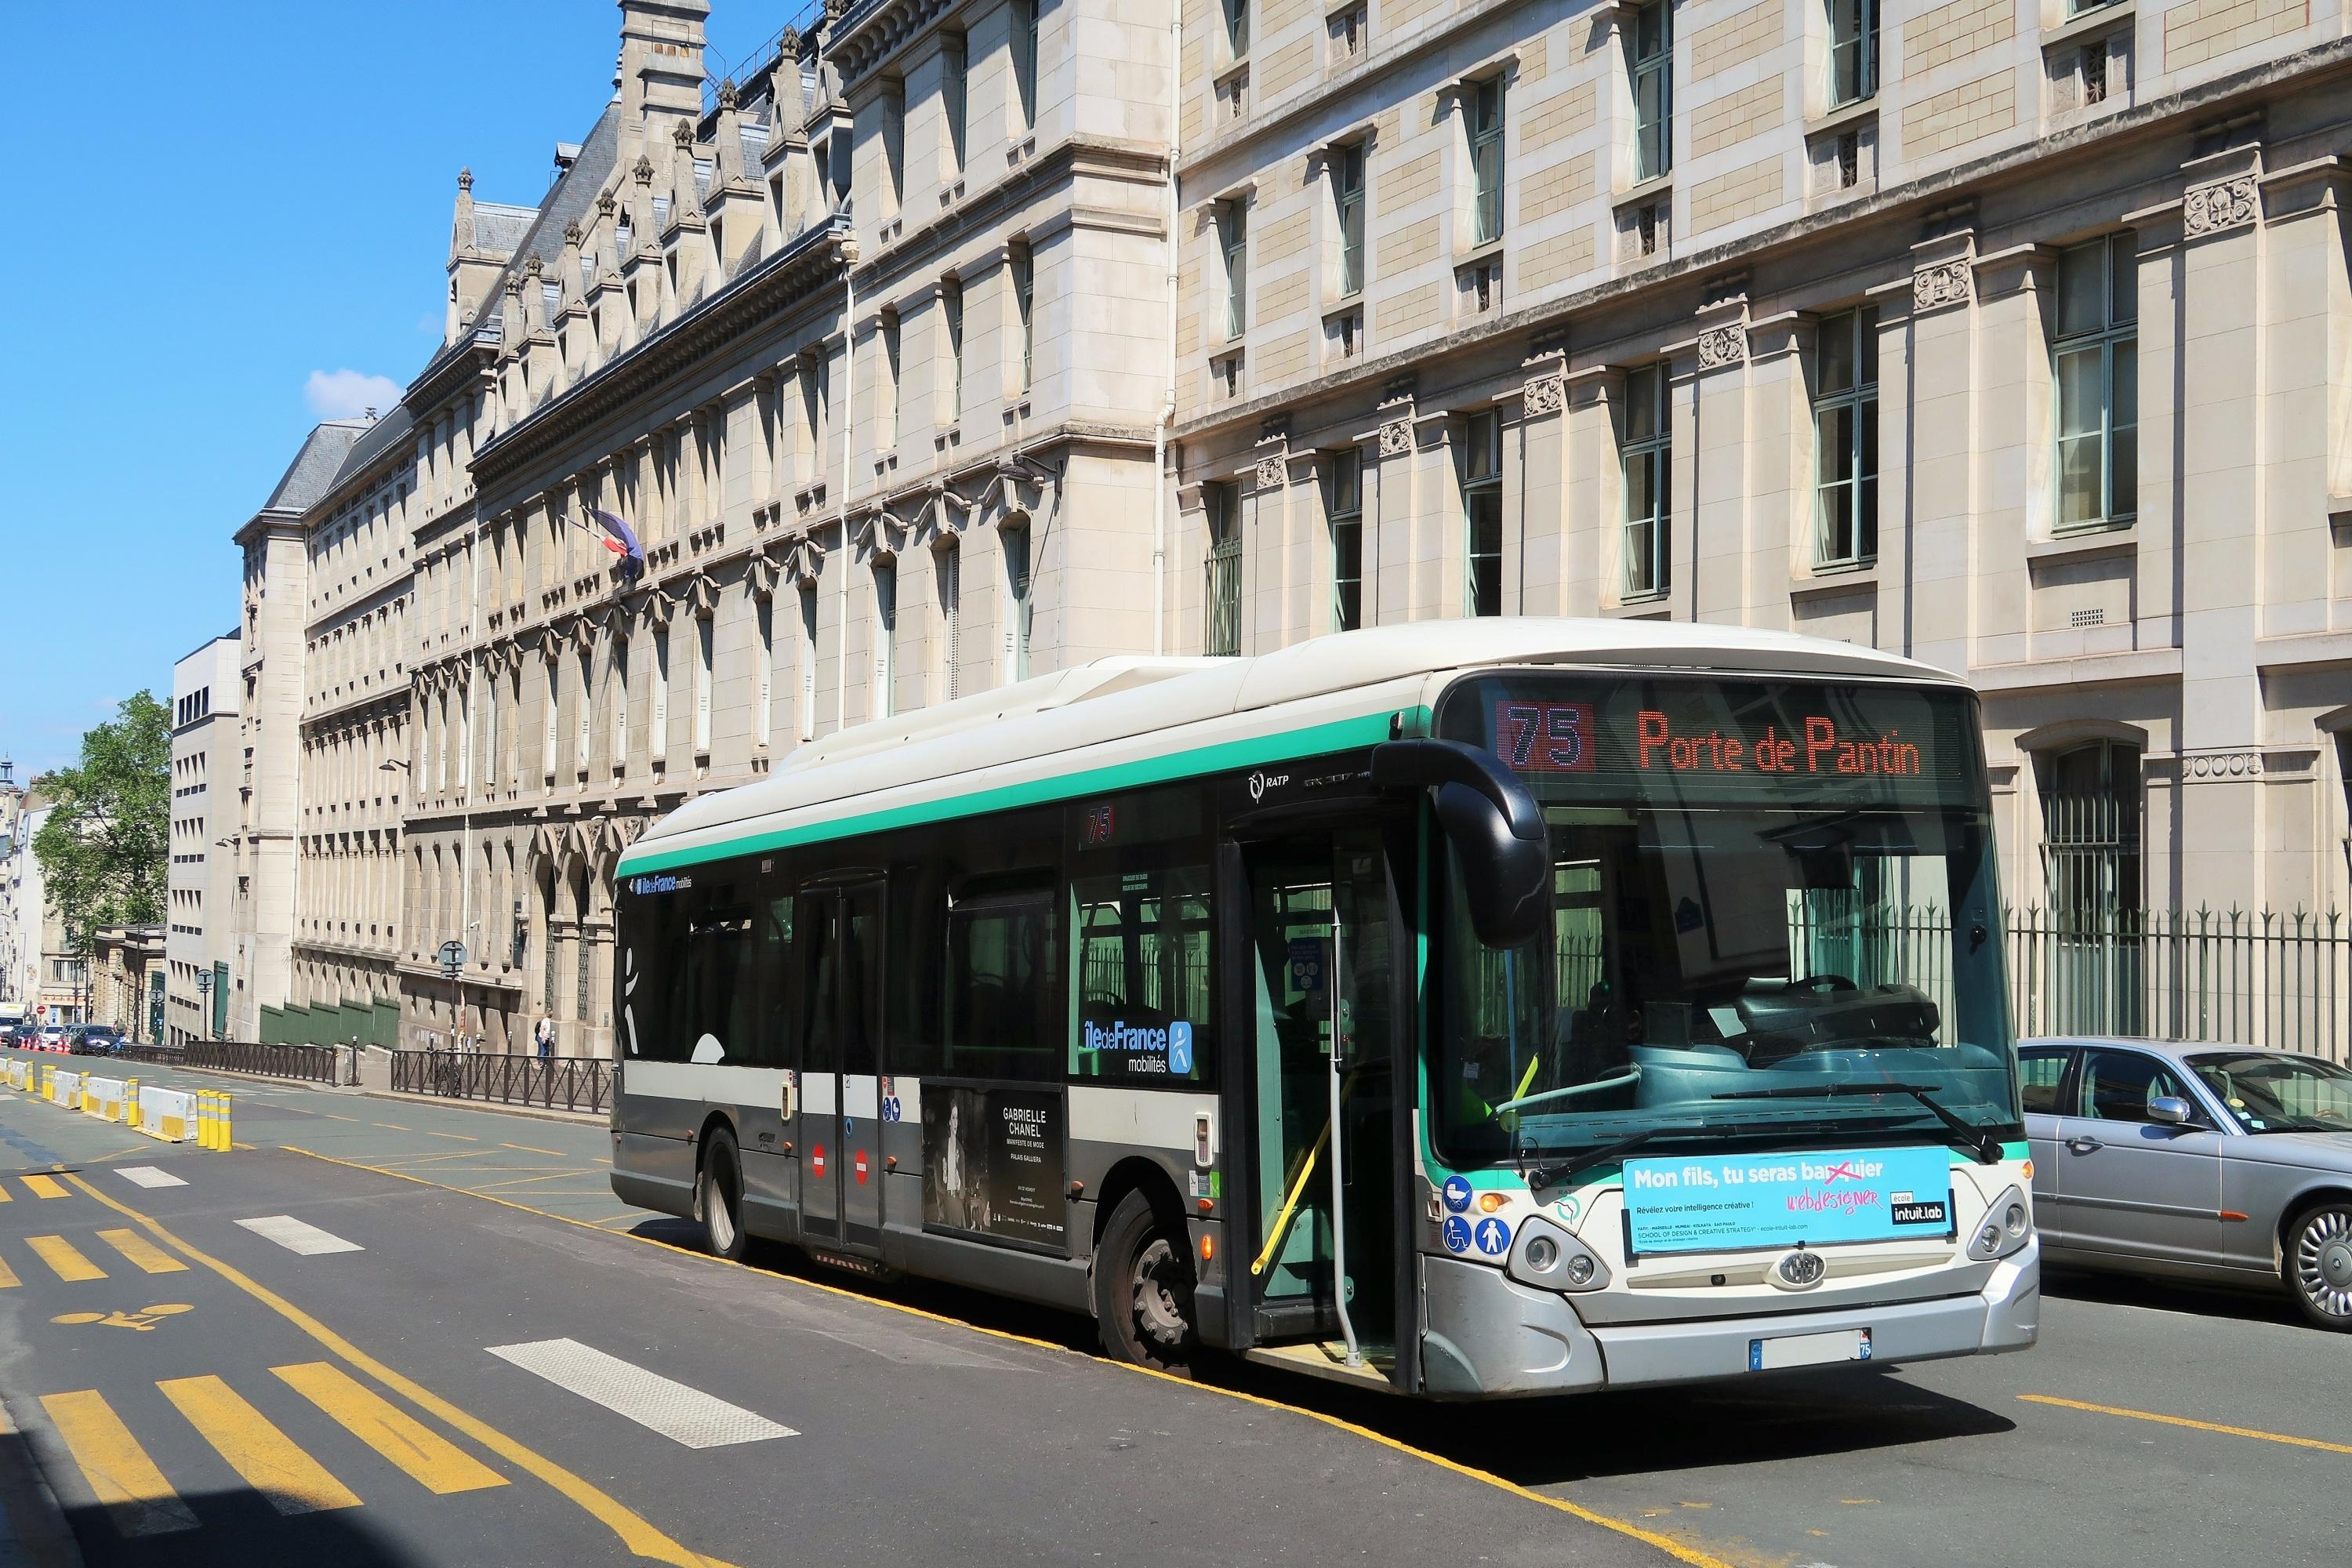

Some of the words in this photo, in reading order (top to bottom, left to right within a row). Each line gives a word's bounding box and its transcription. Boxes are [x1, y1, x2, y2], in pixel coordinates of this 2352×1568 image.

[1508, 706, 1583, 766] 75
[1637, 711, 1744, 771] Porte
[1755, 725, 1796, 772] de
[1806, 717, 1920, 775] Pantin
[1266, 775, 1289, 788] RATP
[1088, 806, 1111, 844] 75
[1128, 1054, 1166, 1073] mobilités
[1004, 1107, 1046, 1123] GABRIELLE
[1009, 1122, 1040, 1137] CHANEL
[1006, 1138, 1026, 1147] MANIFESTE
[1634, 1169, 1679, 1189] Mon
[1682, 1167, 1719, 1189] fils,
[1723, 1166, 1744, 1185] tu
[1748, 1166, 1797, 1184] seras
[1636, 1205, 1663, 1214] Révélez
[1684, 1203, 1722, 1214] intelligence
[1725, 1201, 1750, 1210] créative
[1894, 1206, 1943, 1221] intuit.lab
[1860, 1344, 1871, 1356] 75
